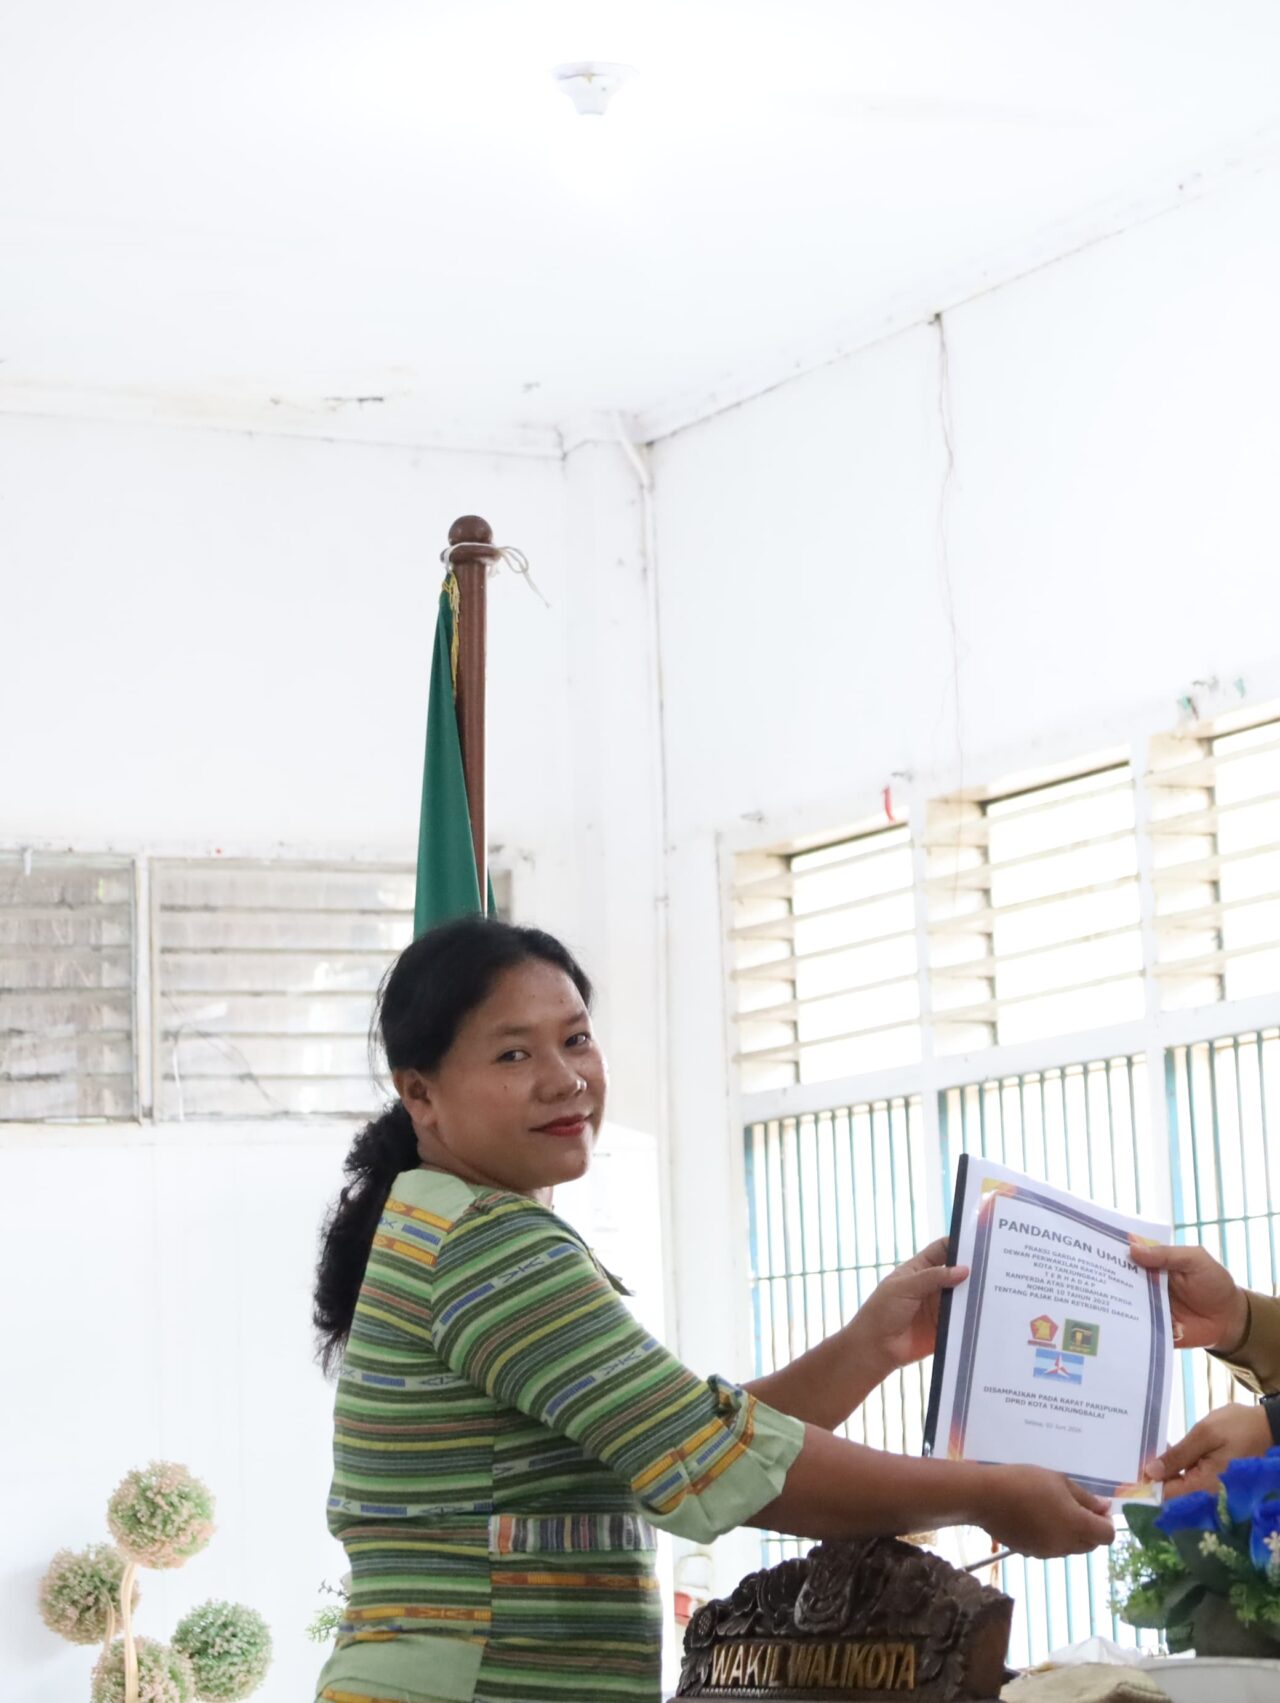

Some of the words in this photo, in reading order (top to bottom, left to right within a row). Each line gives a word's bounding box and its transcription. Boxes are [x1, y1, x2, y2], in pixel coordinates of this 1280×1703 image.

[998, 1218, 1092, 1254] PANDANGAN
[1096, 1247, 1138, 1274] UMUM
[1024, 1244, 1050, 1255] FRAKSI
[1052, 1250, 1076, 1262] GARDA
[1077, 1258, 1116, 1276] PERSATUAN
[1003, 1247, 1031, 1259] DEWAN
[1031, 1253, 1079, 1269] PERWAKILAN
[1080, 1265, 1107, 1278] RAKYAT
[1107, 1274, 1135, 1289] DAERAH
[1033, 1261, 1053, 1271] KOTA
[1055, 1266, 1107, 1285] TANJUNGBALAI
[994, 1284, 1028, 1297] TENTANG
[1029, 1291, 1052, 1302] PAJAK
[1053, 1295, 1070, 1305] DAN
[1070, 1299, 1110, 1314] RETRIBUSI
[1111, 1308, 1139, 1321] DAERAH
[1005, 1271, 1045, 1285] RANPERDA
[1046, 1278, 1065, 1289] ATAS
[1066, 1283, 1109, 1299] PERUBAHAN
[1110, 1294, 1133, 1307] PERDA
[1026, 1283, 1054, 1294] NOMOR
[1056, 1288, 1065, 1296] 10
[1067, 1291, 1091, 1302] TAHUN
[983, 1385, 1037, 1400] DISAMPAIKAN
[1038, 1393, 1058, 1404] PADA
[1059, 1396, 1084, 1407] RAPAT
[1085, 1400, 1129, 1416] PARIPURNA
[1005, 1396, 1026, 1406] DPRD
[1027, 1400, 1048, 1410] KOTA
[1050, 1404, 1105, 1420] TANJUNGBALAI
[710, 1644, 781, 1686] WAKIL
[786, 1642, 917, 1690] WALIKOTA
